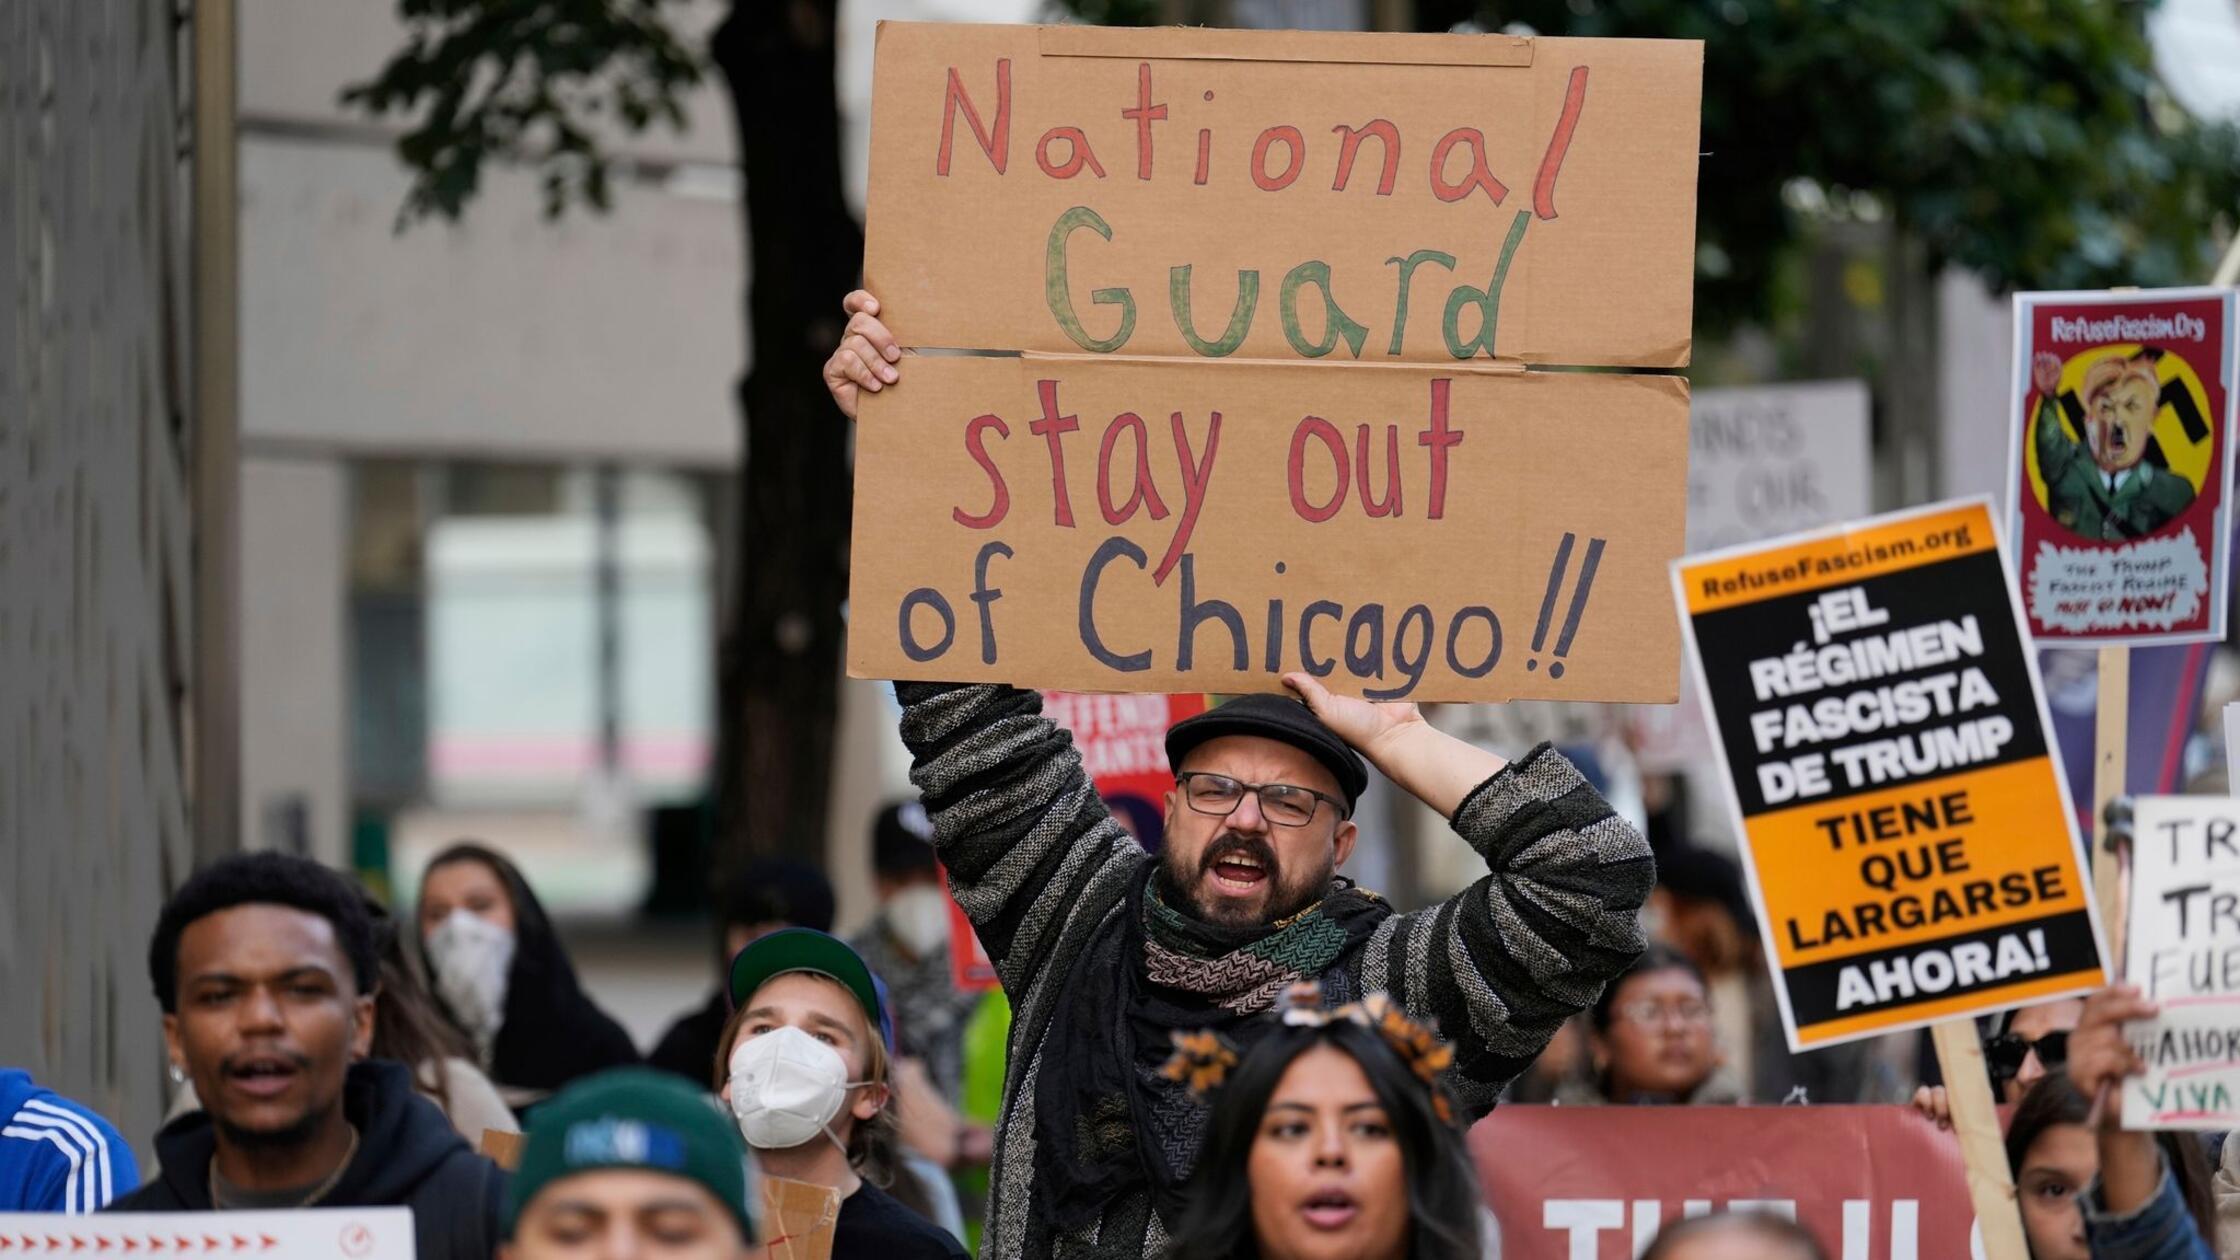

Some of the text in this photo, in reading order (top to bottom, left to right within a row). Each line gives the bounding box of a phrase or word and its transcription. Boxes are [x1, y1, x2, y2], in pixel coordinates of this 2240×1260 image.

[936, 57, 1590, 220] National
[1045, 205, 1532, 361] Guard
[952, 377, 1465, 588] stay out
[898, 541, 1014, 666] of
[1702, 522, 1974, 599] RefuseFascism.org
[1748, 615, 1985, 701] RÉGIMEN
[1807, 586, 1889, 644] ¡EL
[1750, 666, 2000, 754] FASCISTA
[1756, 715, 2015, 805] DE TRUMP
[1815, 790, 1976, 851] TIENE
[1859, 838, 1971, 890] QUE
[1786, 864, 2068, 952] LARGARSE
[1836, 928, 2052, 1012] AHORA!
